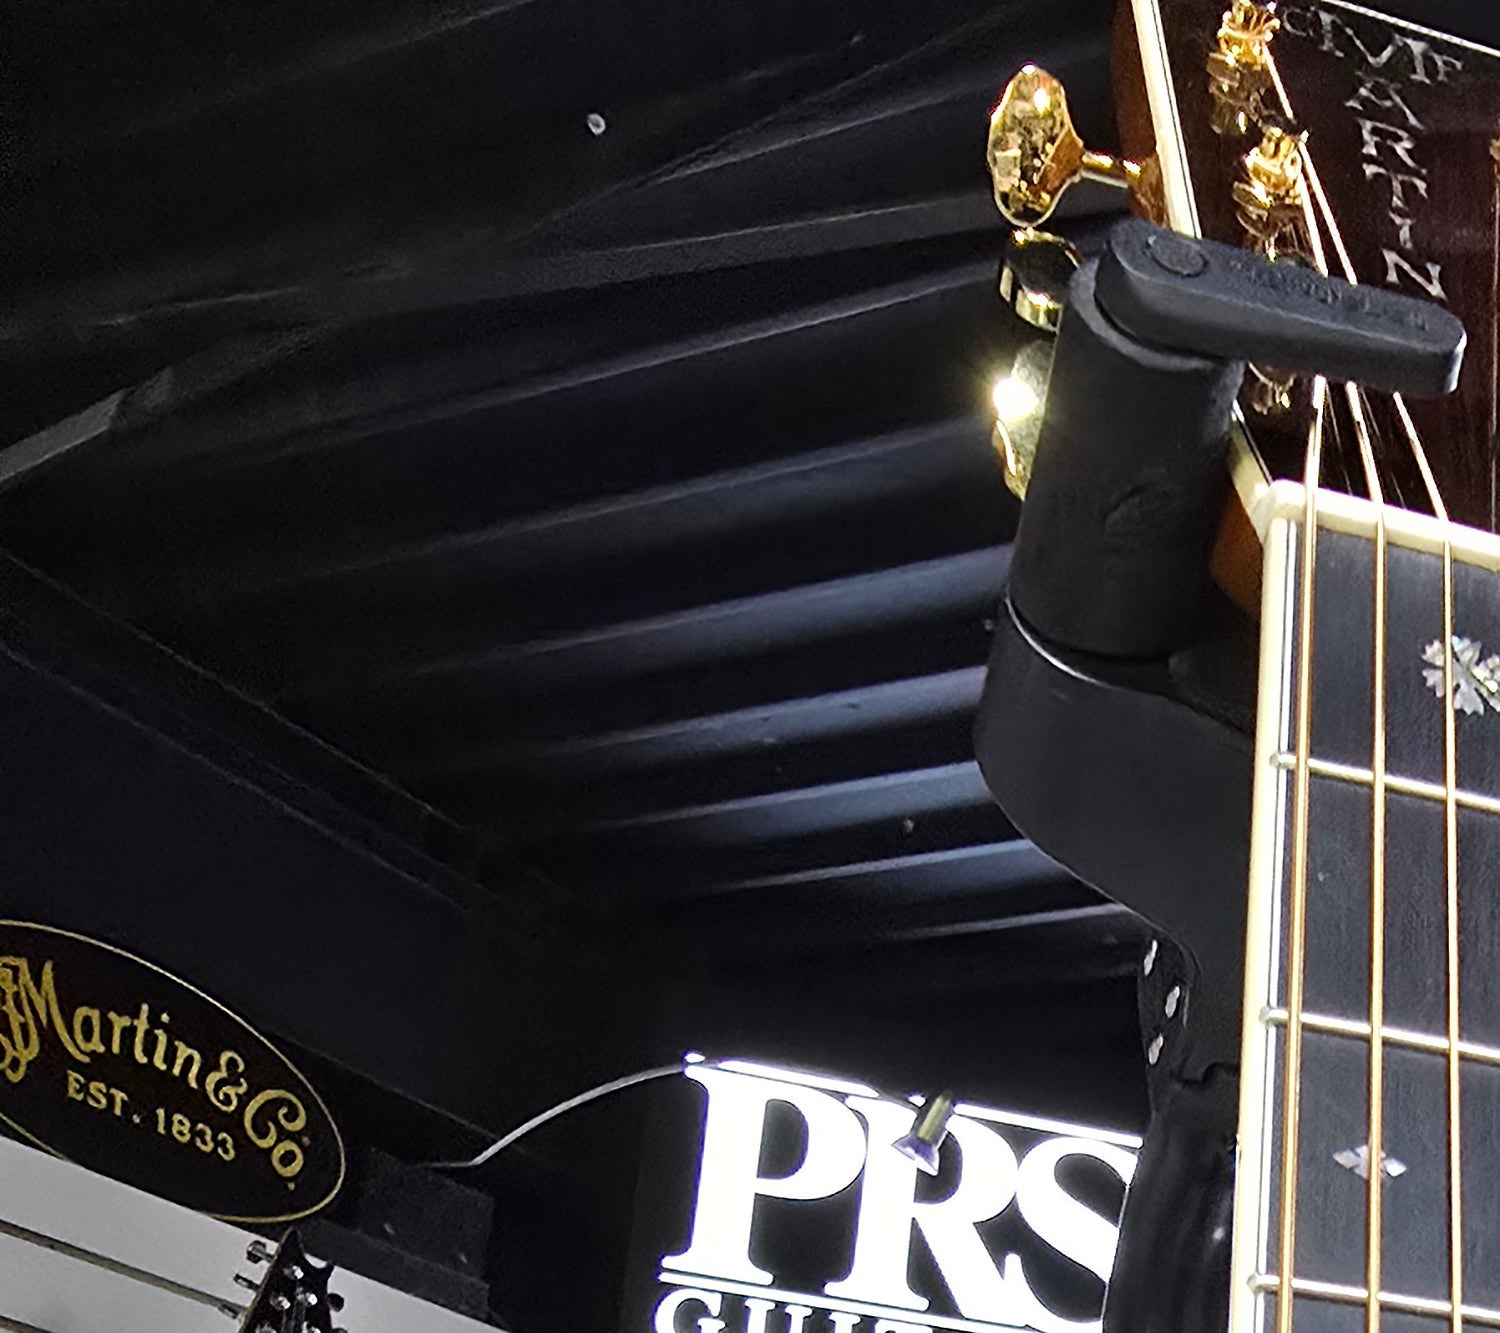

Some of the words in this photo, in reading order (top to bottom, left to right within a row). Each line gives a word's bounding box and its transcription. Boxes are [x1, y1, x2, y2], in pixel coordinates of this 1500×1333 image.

[1312, 8, 1449, 300] MARTIN
[66, 1069, 141, 1124] EST.
[156, 1108, 236, 1161] 1833
